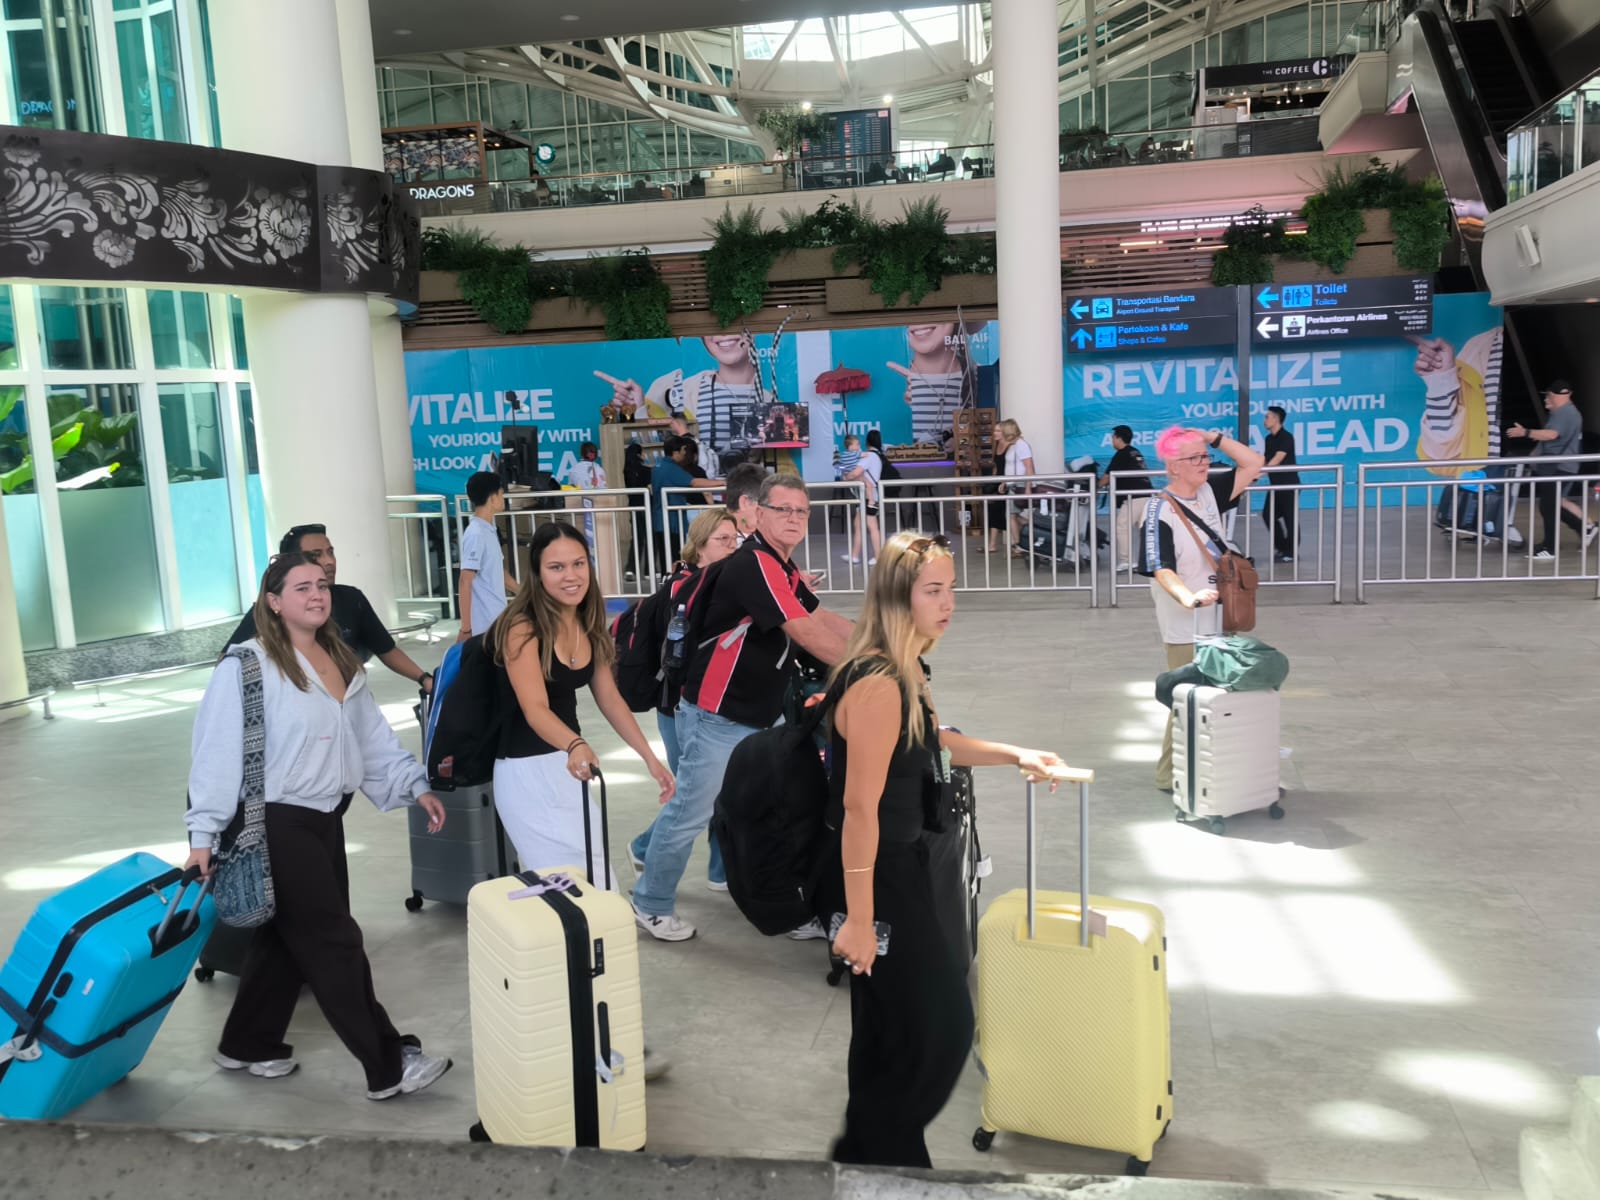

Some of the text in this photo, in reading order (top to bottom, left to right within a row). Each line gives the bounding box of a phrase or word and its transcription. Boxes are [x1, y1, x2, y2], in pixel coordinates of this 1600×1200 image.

[1275, 65, 1310, 76] COFFEE
[409, 184, 475, 200] DRAGONS
[1314, 283, 1348, 295] Toilet
[1116, 293, 1196, 307] Transportasi Bandara
[1306, 314, 1356, 325] Perkantoran
[1356, 312, 1388, 322] Airlines
[1118, 324, 1160, 334] Pertokoan
[1169, 321, 1189, 332] Kafe
[944, 333, 969, 346] BAL
[1083, 351, 1341, 400] REVITALIZE
[1180, 393, 1386, 419] YOUR OURNEY WITH
[546, 427, 592, 443] WITH
[833, 420, 881, 436] WITH
[432, 455, 477, 471] LOOK
